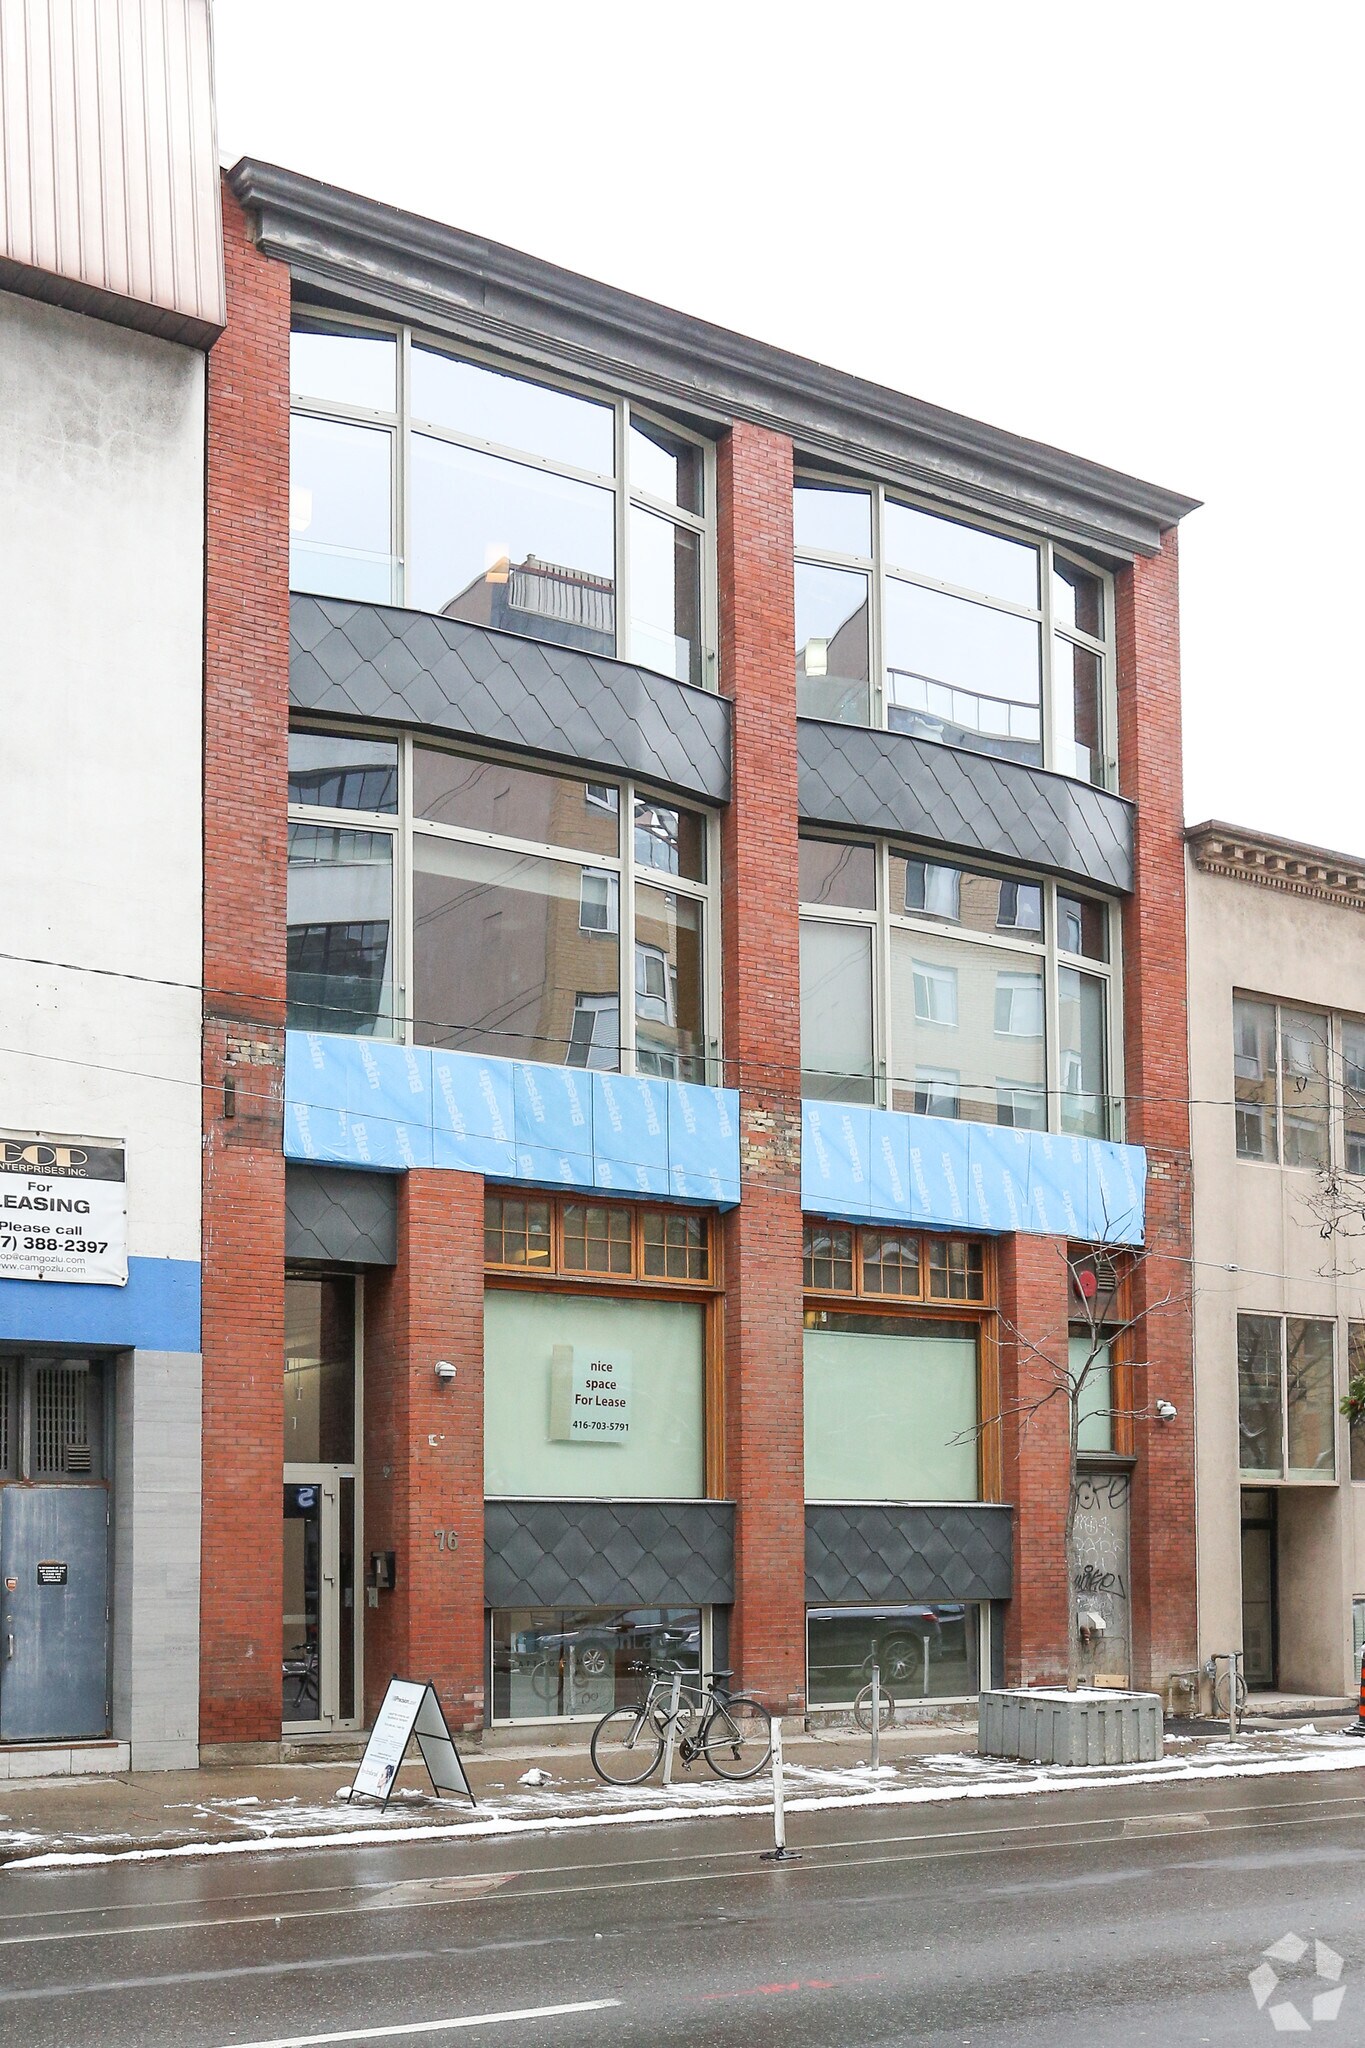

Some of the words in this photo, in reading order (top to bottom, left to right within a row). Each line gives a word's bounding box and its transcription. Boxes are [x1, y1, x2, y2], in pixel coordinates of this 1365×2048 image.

[437, 1065, 466, 1141] Blueskin
[478, 1068, 508, 1144] Blueskin
[808, 1110, 831, 1180] Blueskin
[841, 1115, 864, 1183] Blueskin
[68, 1168, 89, 1177] INC.
[881, 1136, 904, 1203] Blueskin
[28, 1181, 53, 1192] For
[910, 1147, 932, 1215] Blueskin
[941, 1151, 963, 1218] Blueskin
[0, 1221, 51, 1234] Please
[56, 1225, 83, 1236] call
[24, 1237, 108, 1254] 388-2397
[590, 1360, 613, 1372] nice
[585, 1379, 617, 1391] space
[575, 1393, 593, 1406] For
[595, 1395, 626, 1408] Lease
[572, 1420, 629, 1432] 416-703-5791
[434, 1529, 459, 1551] 76
